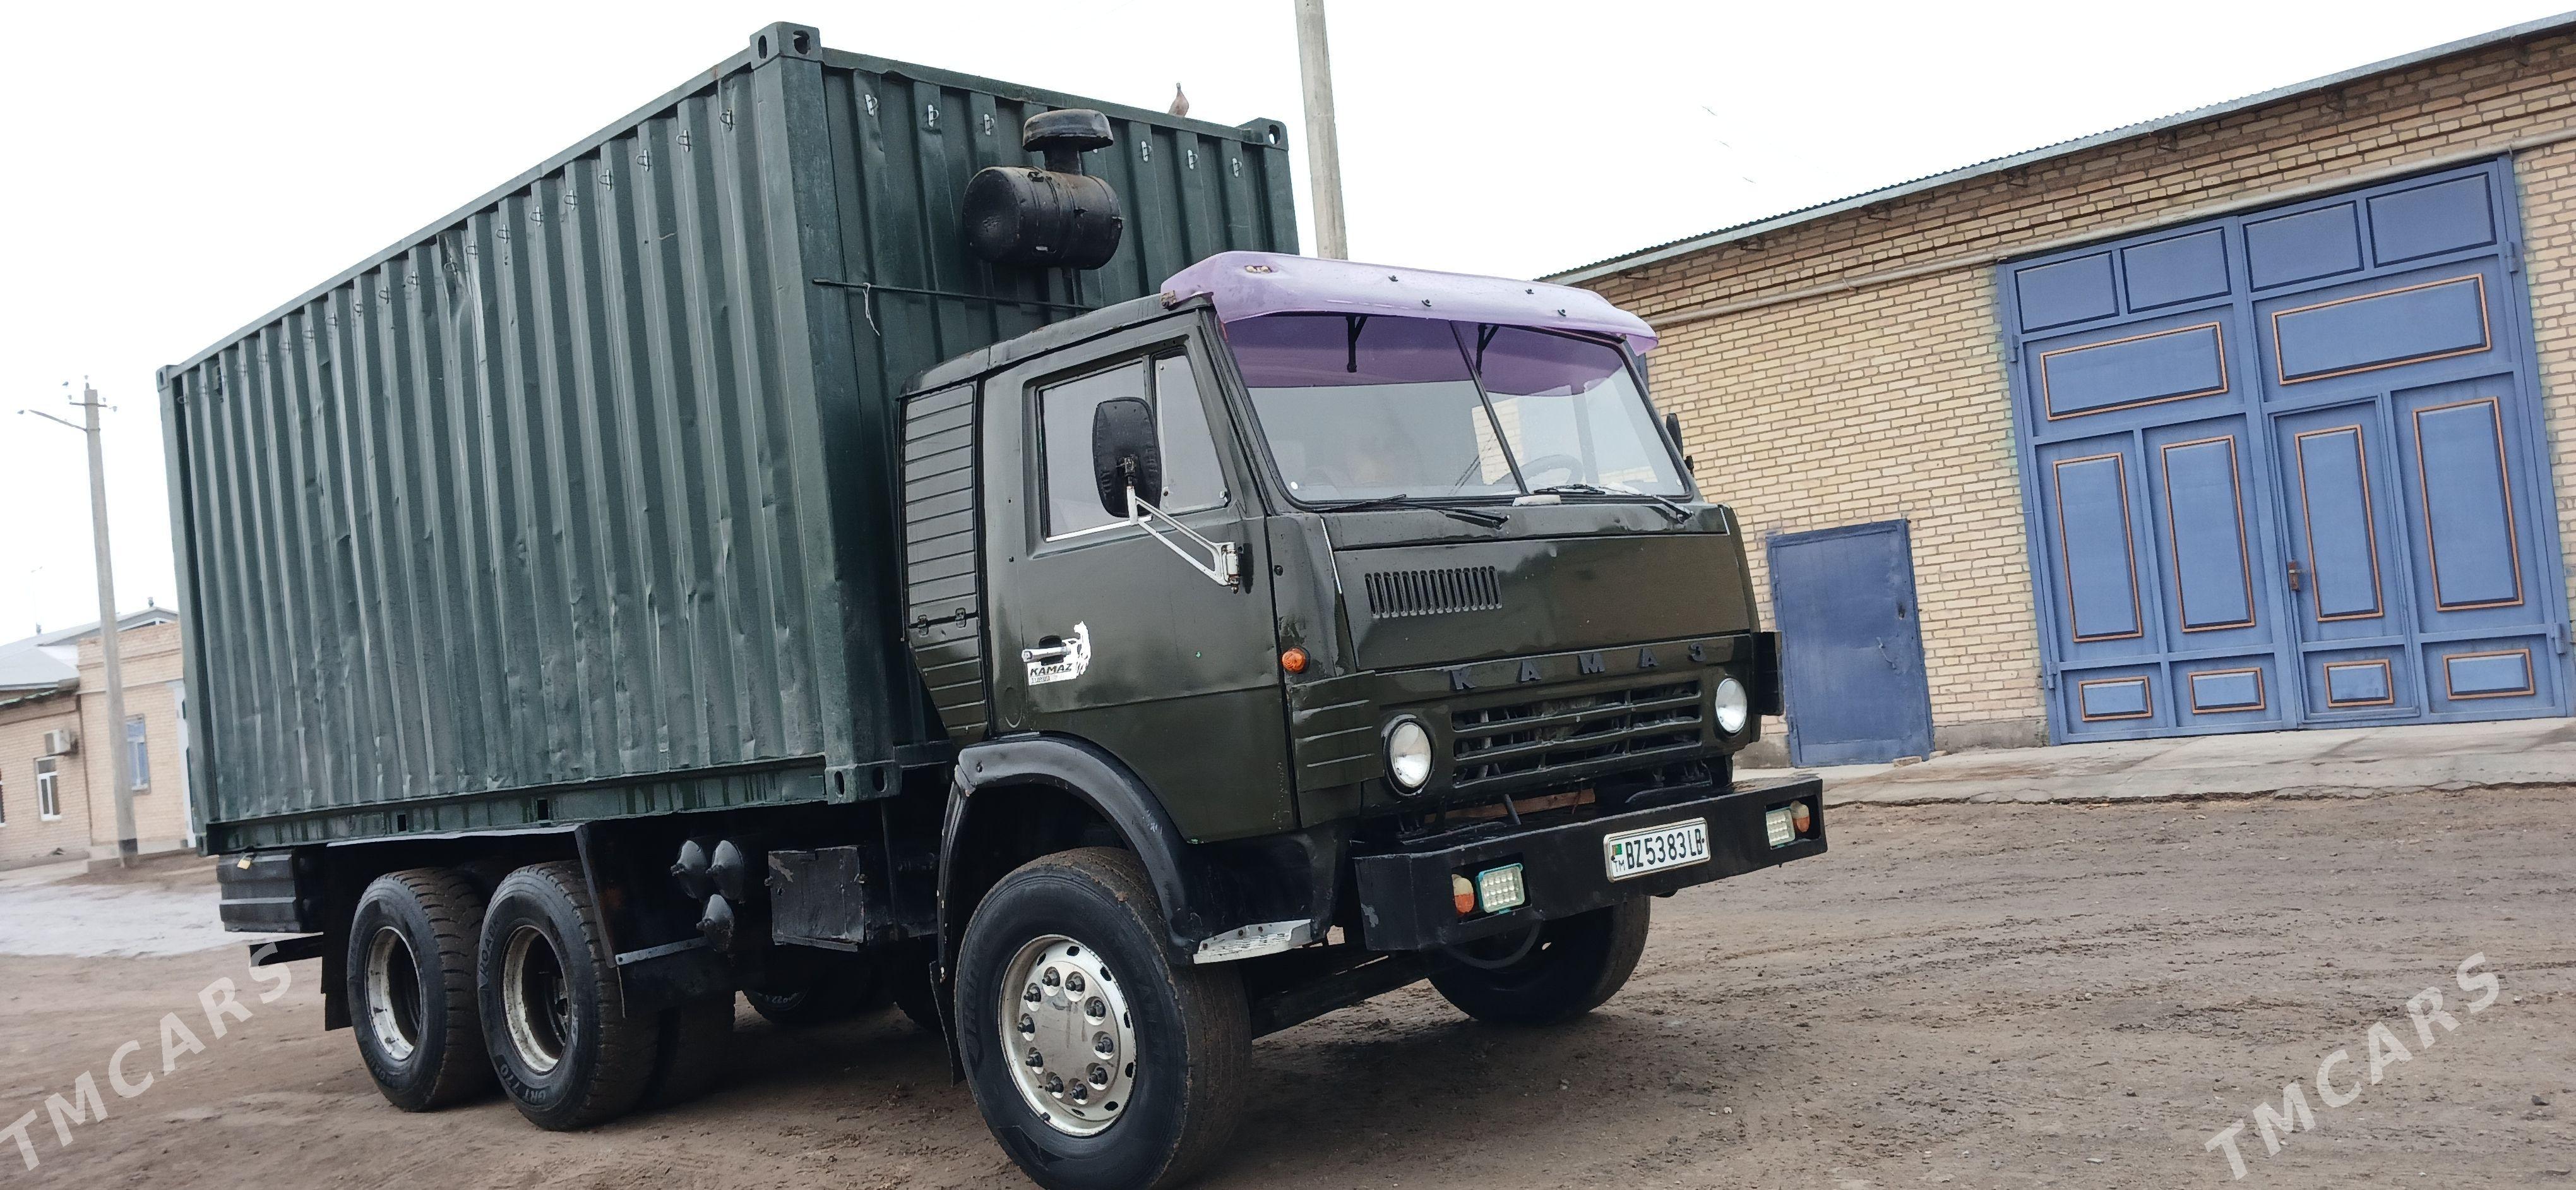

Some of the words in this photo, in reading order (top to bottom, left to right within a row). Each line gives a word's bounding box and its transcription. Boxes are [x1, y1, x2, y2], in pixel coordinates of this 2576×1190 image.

[1030, 663, 1073, 676] KAMAZ
[1613, 860, 1625, 872] TM
[499, 1063, 520, 1094] 770
